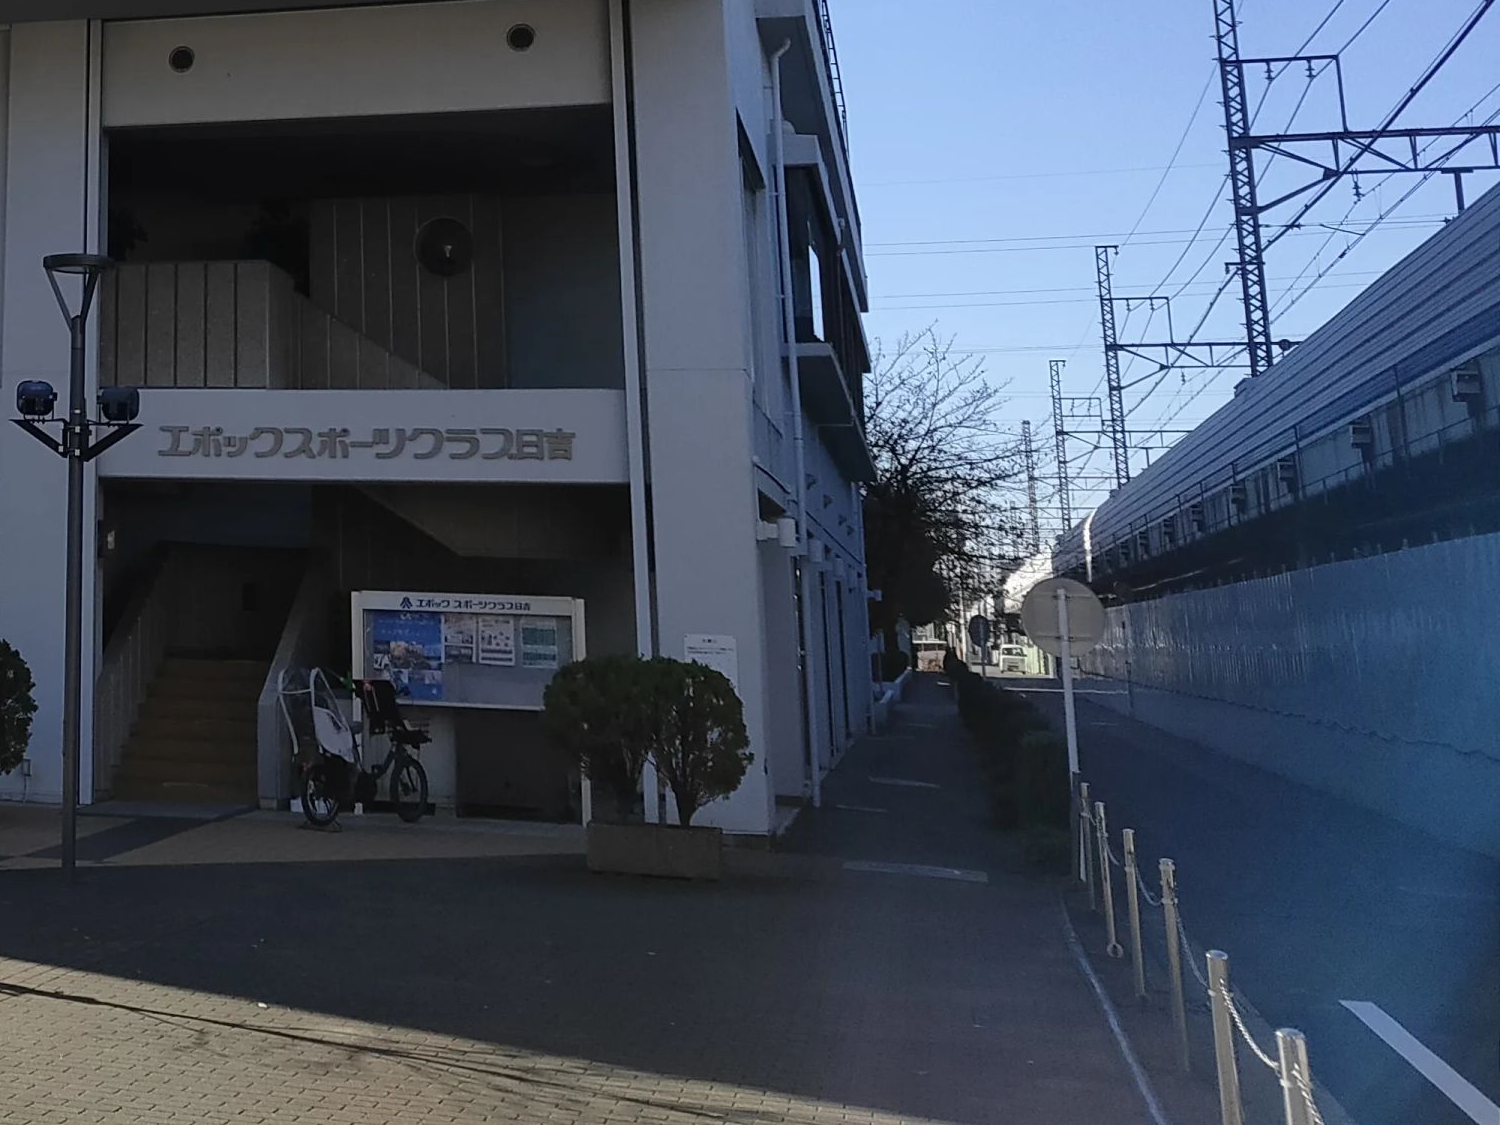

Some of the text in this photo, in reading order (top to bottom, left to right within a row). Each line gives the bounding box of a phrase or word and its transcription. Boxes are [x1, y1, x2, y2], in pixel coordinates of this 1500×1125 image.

[158, 426, 576, 461] エポックスポーツクラブ日吉
